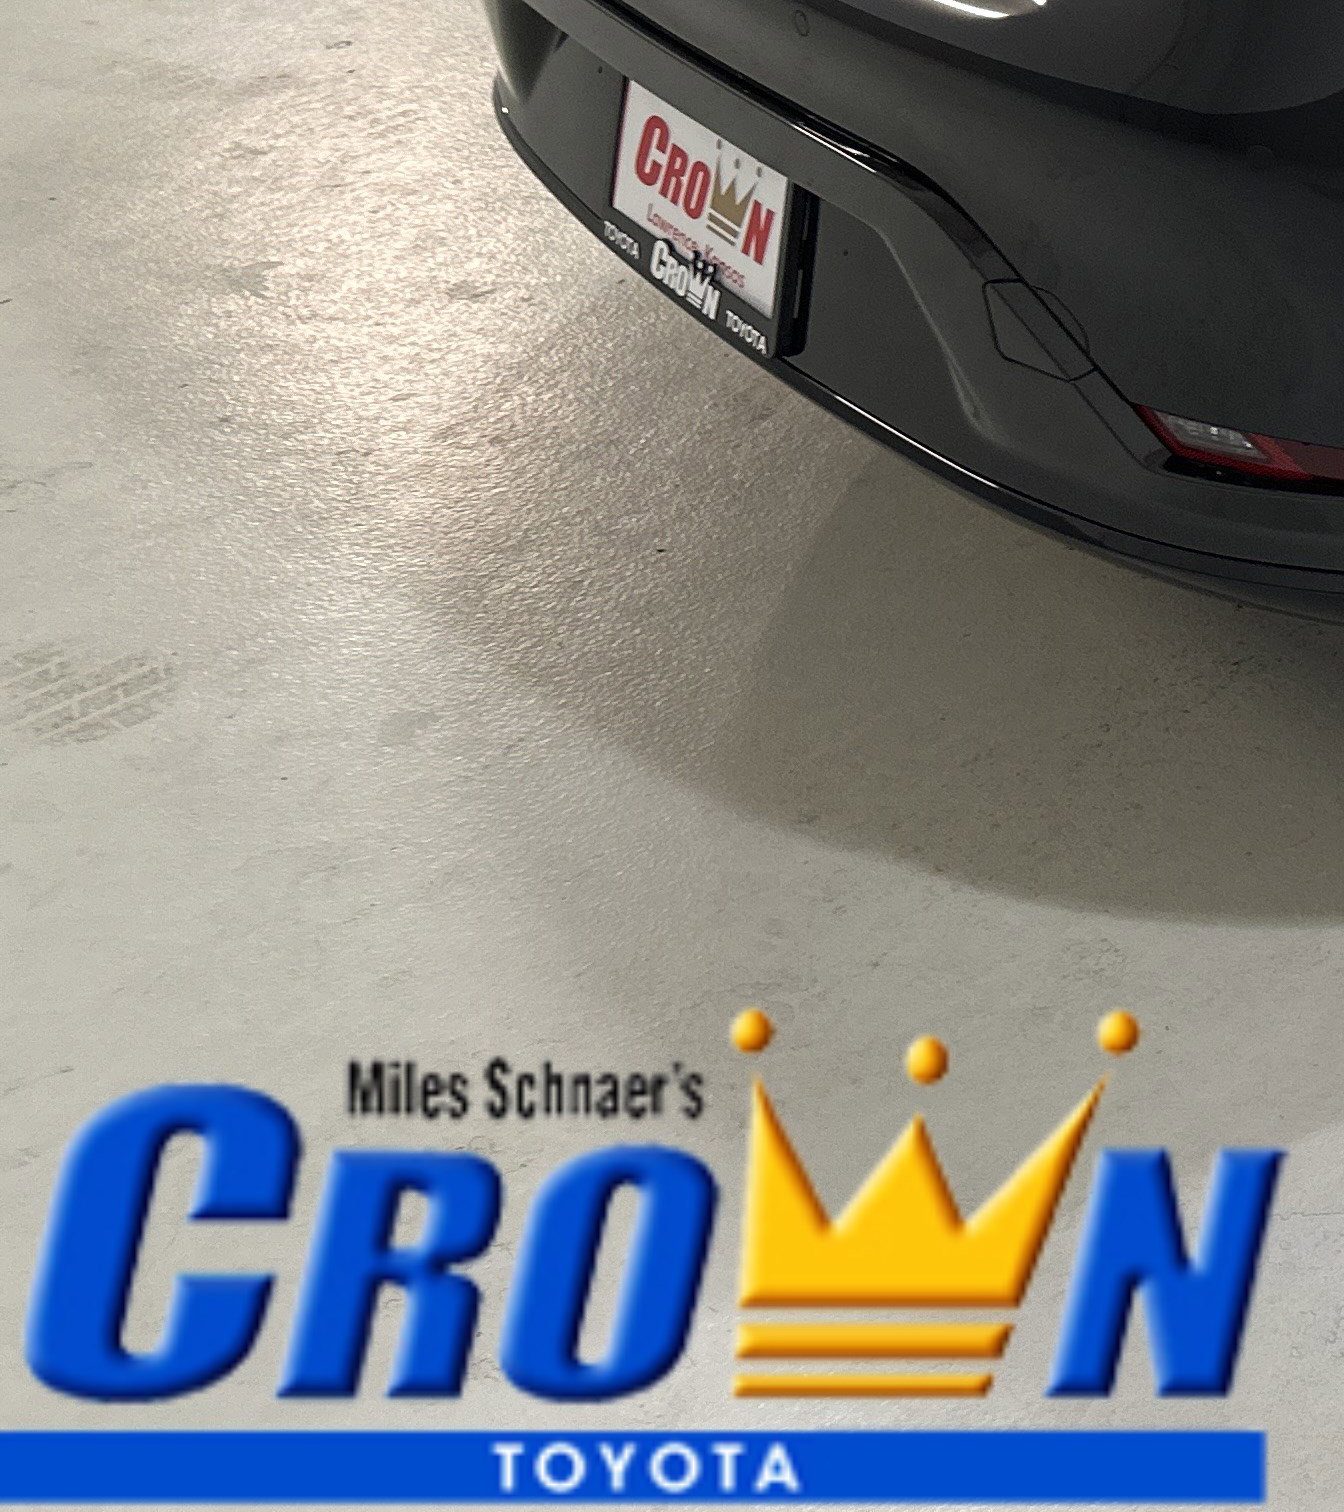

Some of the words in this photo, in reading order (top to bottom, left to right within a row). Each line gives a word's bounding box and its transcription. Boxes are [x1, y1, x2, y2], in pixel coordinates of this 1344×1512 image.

[634, 114, 776, 266] CROWN
[602, 219, 642, 261] TOYOTA
[649, 238, 722, 321] CROWN
[725, 309, 769, 355] TOYOTA
